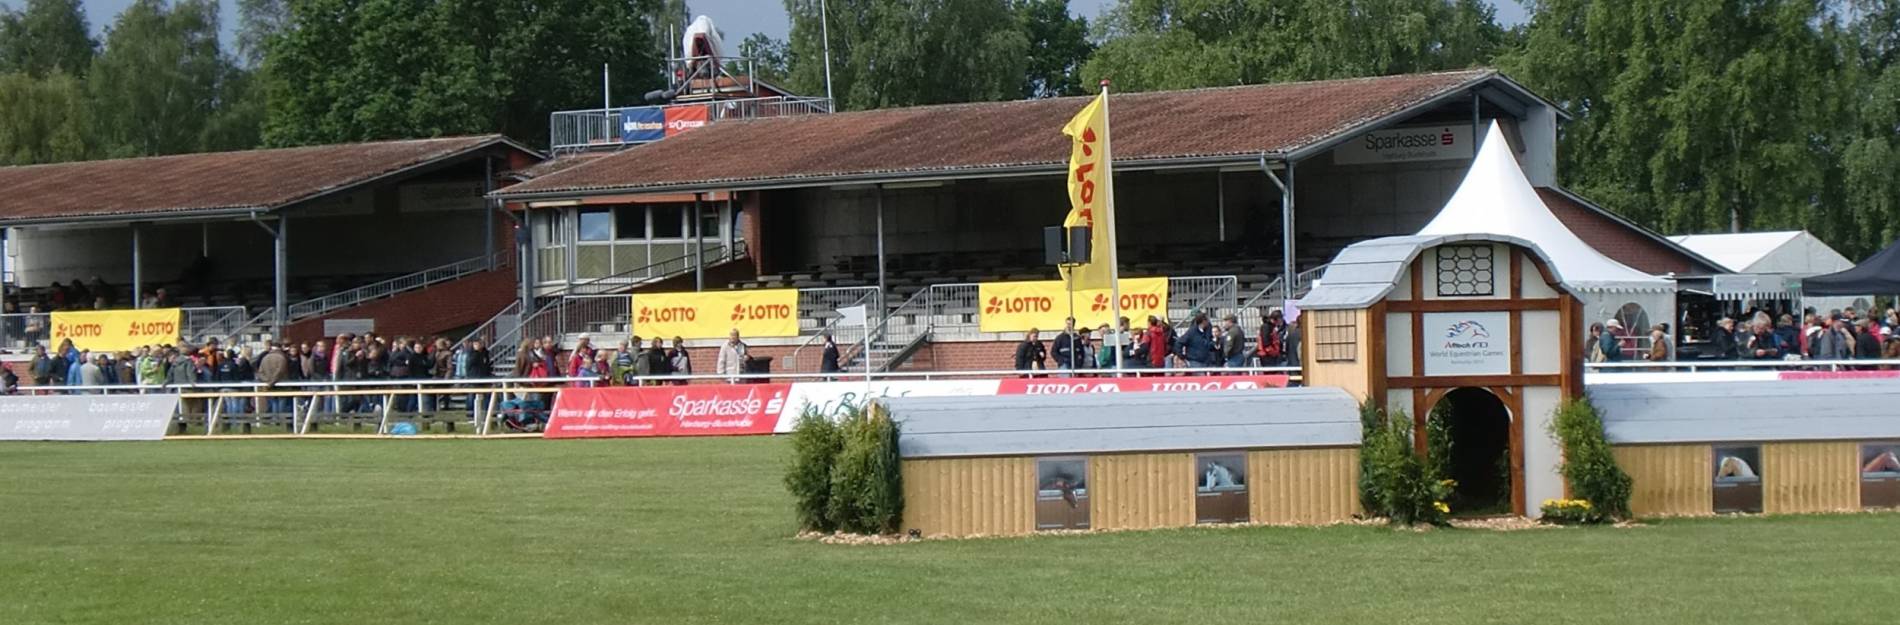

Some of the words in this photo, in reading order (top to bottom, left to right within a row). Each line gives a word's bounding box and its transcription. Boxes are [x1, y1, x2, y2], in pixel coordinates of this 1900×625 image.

[1365, 132, 1437, 152] Sparkasse
[1005, 297, 1052, 313] LOTTO
[1112, 293, 1160, 311] OTTO
[654, 307, 697, 322] LOTTO
[748, 304, 791, 320] LOTTO
[69, 323, 102, 337] LOTTO
[142, 321, 175, 336] LOTTO
[668, 394, 762, 420] Sparkasse
